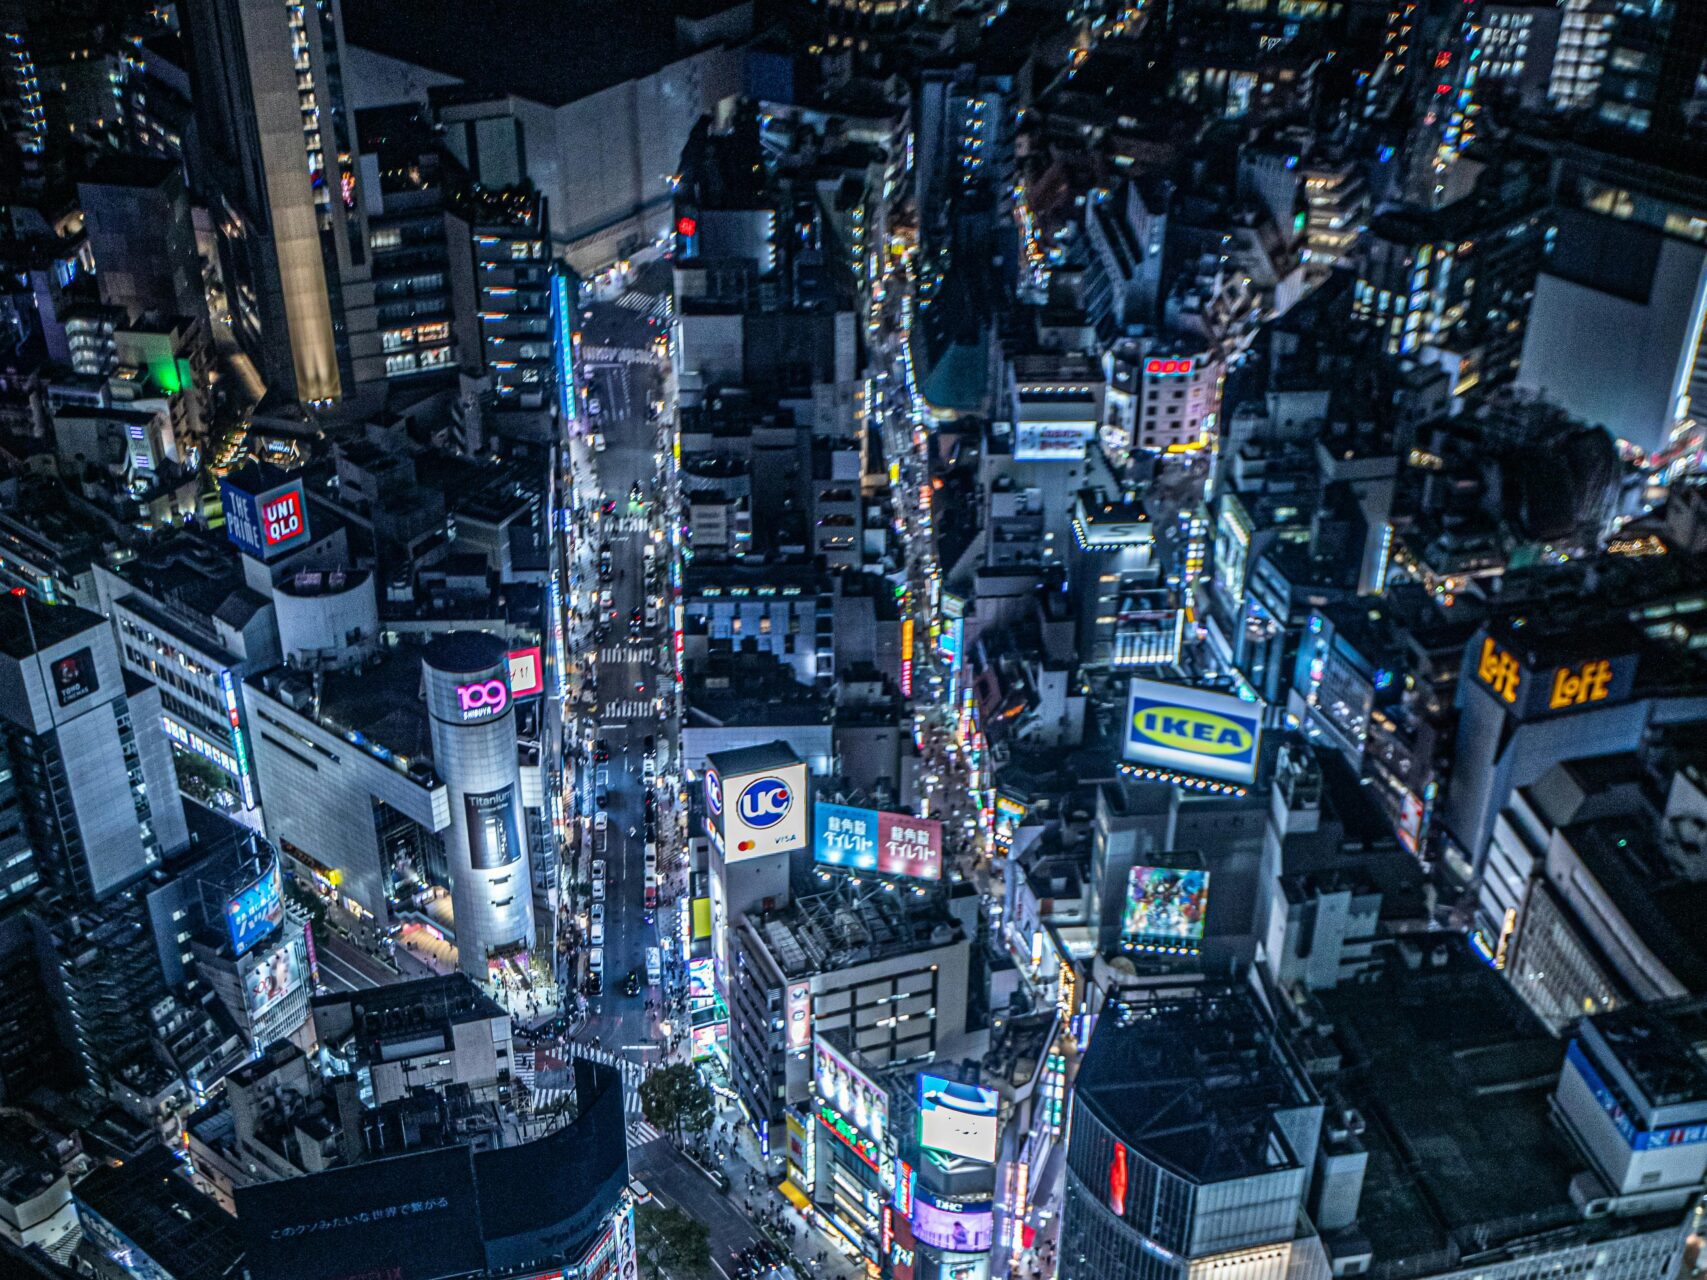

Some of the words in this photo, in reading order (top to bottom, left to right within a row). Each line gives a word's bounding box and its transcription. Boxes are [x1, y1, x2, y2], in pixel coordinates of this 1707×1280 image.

[229, 491, 250, 520] THE
[267, 499, 294, 521] UNI
[227, 512, 260, 548] PRIME
[270, 515, 298, 540] QLO
[456, 680, 507, 714] 109
[1550, 659, 1613, 710] Loft
[463, 706, 492, 720] SHIBUYA
[1145, 713, 1244, 748] IKEA
[743, 788, 788, 817] UC
[775, 834, 797, 844] VISA
[936, 1199, 963, 1212] DHC
